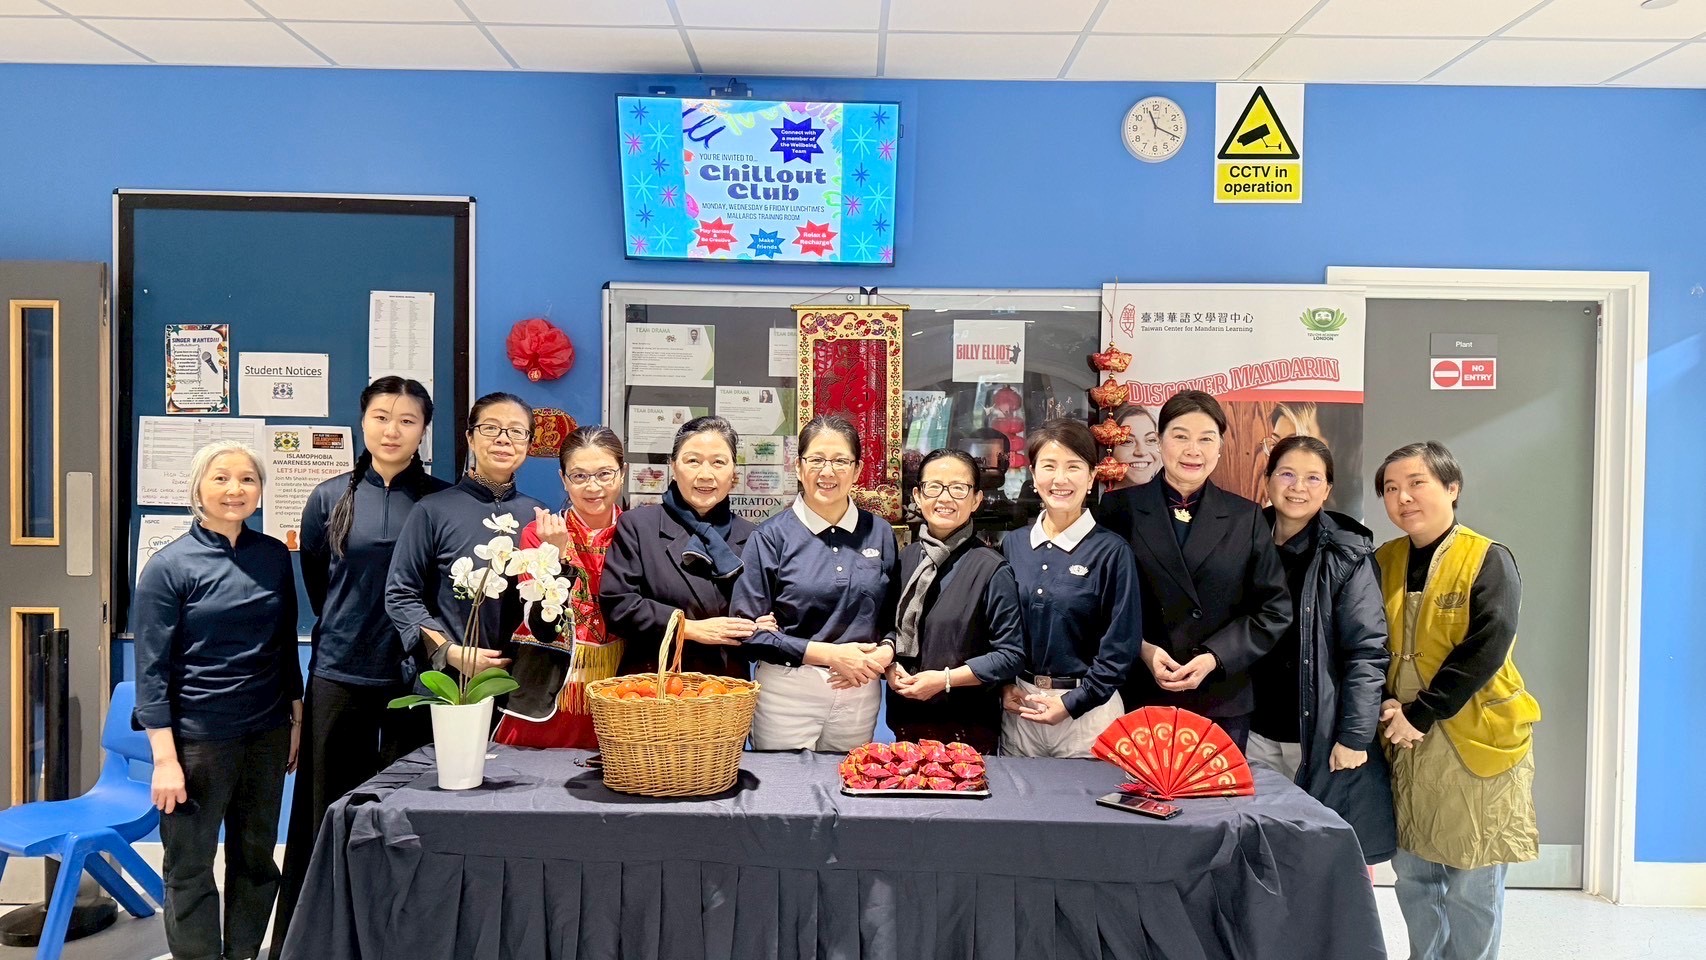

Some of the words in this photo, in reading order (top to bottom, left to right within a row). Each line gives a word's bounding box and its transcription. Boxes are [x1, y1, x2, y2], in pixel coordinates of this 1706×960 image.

[1152, 104, 1160, 112] 12
[1135, 114, 1143, 122] 10
[1171, 114, 1177, 122] 2
[1135, 135, 1141, 143] 8
[1142, 142, 1148, 150] 7
[1162, 142, 1169, 150] 5
[699, 153, 721, 161] YOU'RE
[721, 154, 745, 162] INVITED
[699, 164, 827, 185] Chillout
[1229, 165, 1271, 178] CCTV
[1275, 166, 1288, 178] in
[727, 183, 799, 201] Club
[1223, 180, 1293, 196] operation
[702, 203, 728, 211] MONDAY,
[728, 204, 763, 212] WEDNESDAY
[769, 205, 790, 213] FRIDAY
[1140, 312, 1254, 324] 臺灣華語文學習中心
[956, 344, 980, 360] BILLY
[982, 344, 1011, 360] ELLIOT
[244, 365, 282, 375] Student
[285, 366, 322, 376] Notices
[1230, 357, 1339, 390] MANDARIN
[312, 459, 334, 467] MONTH
[152, 539, 171, 547] What
